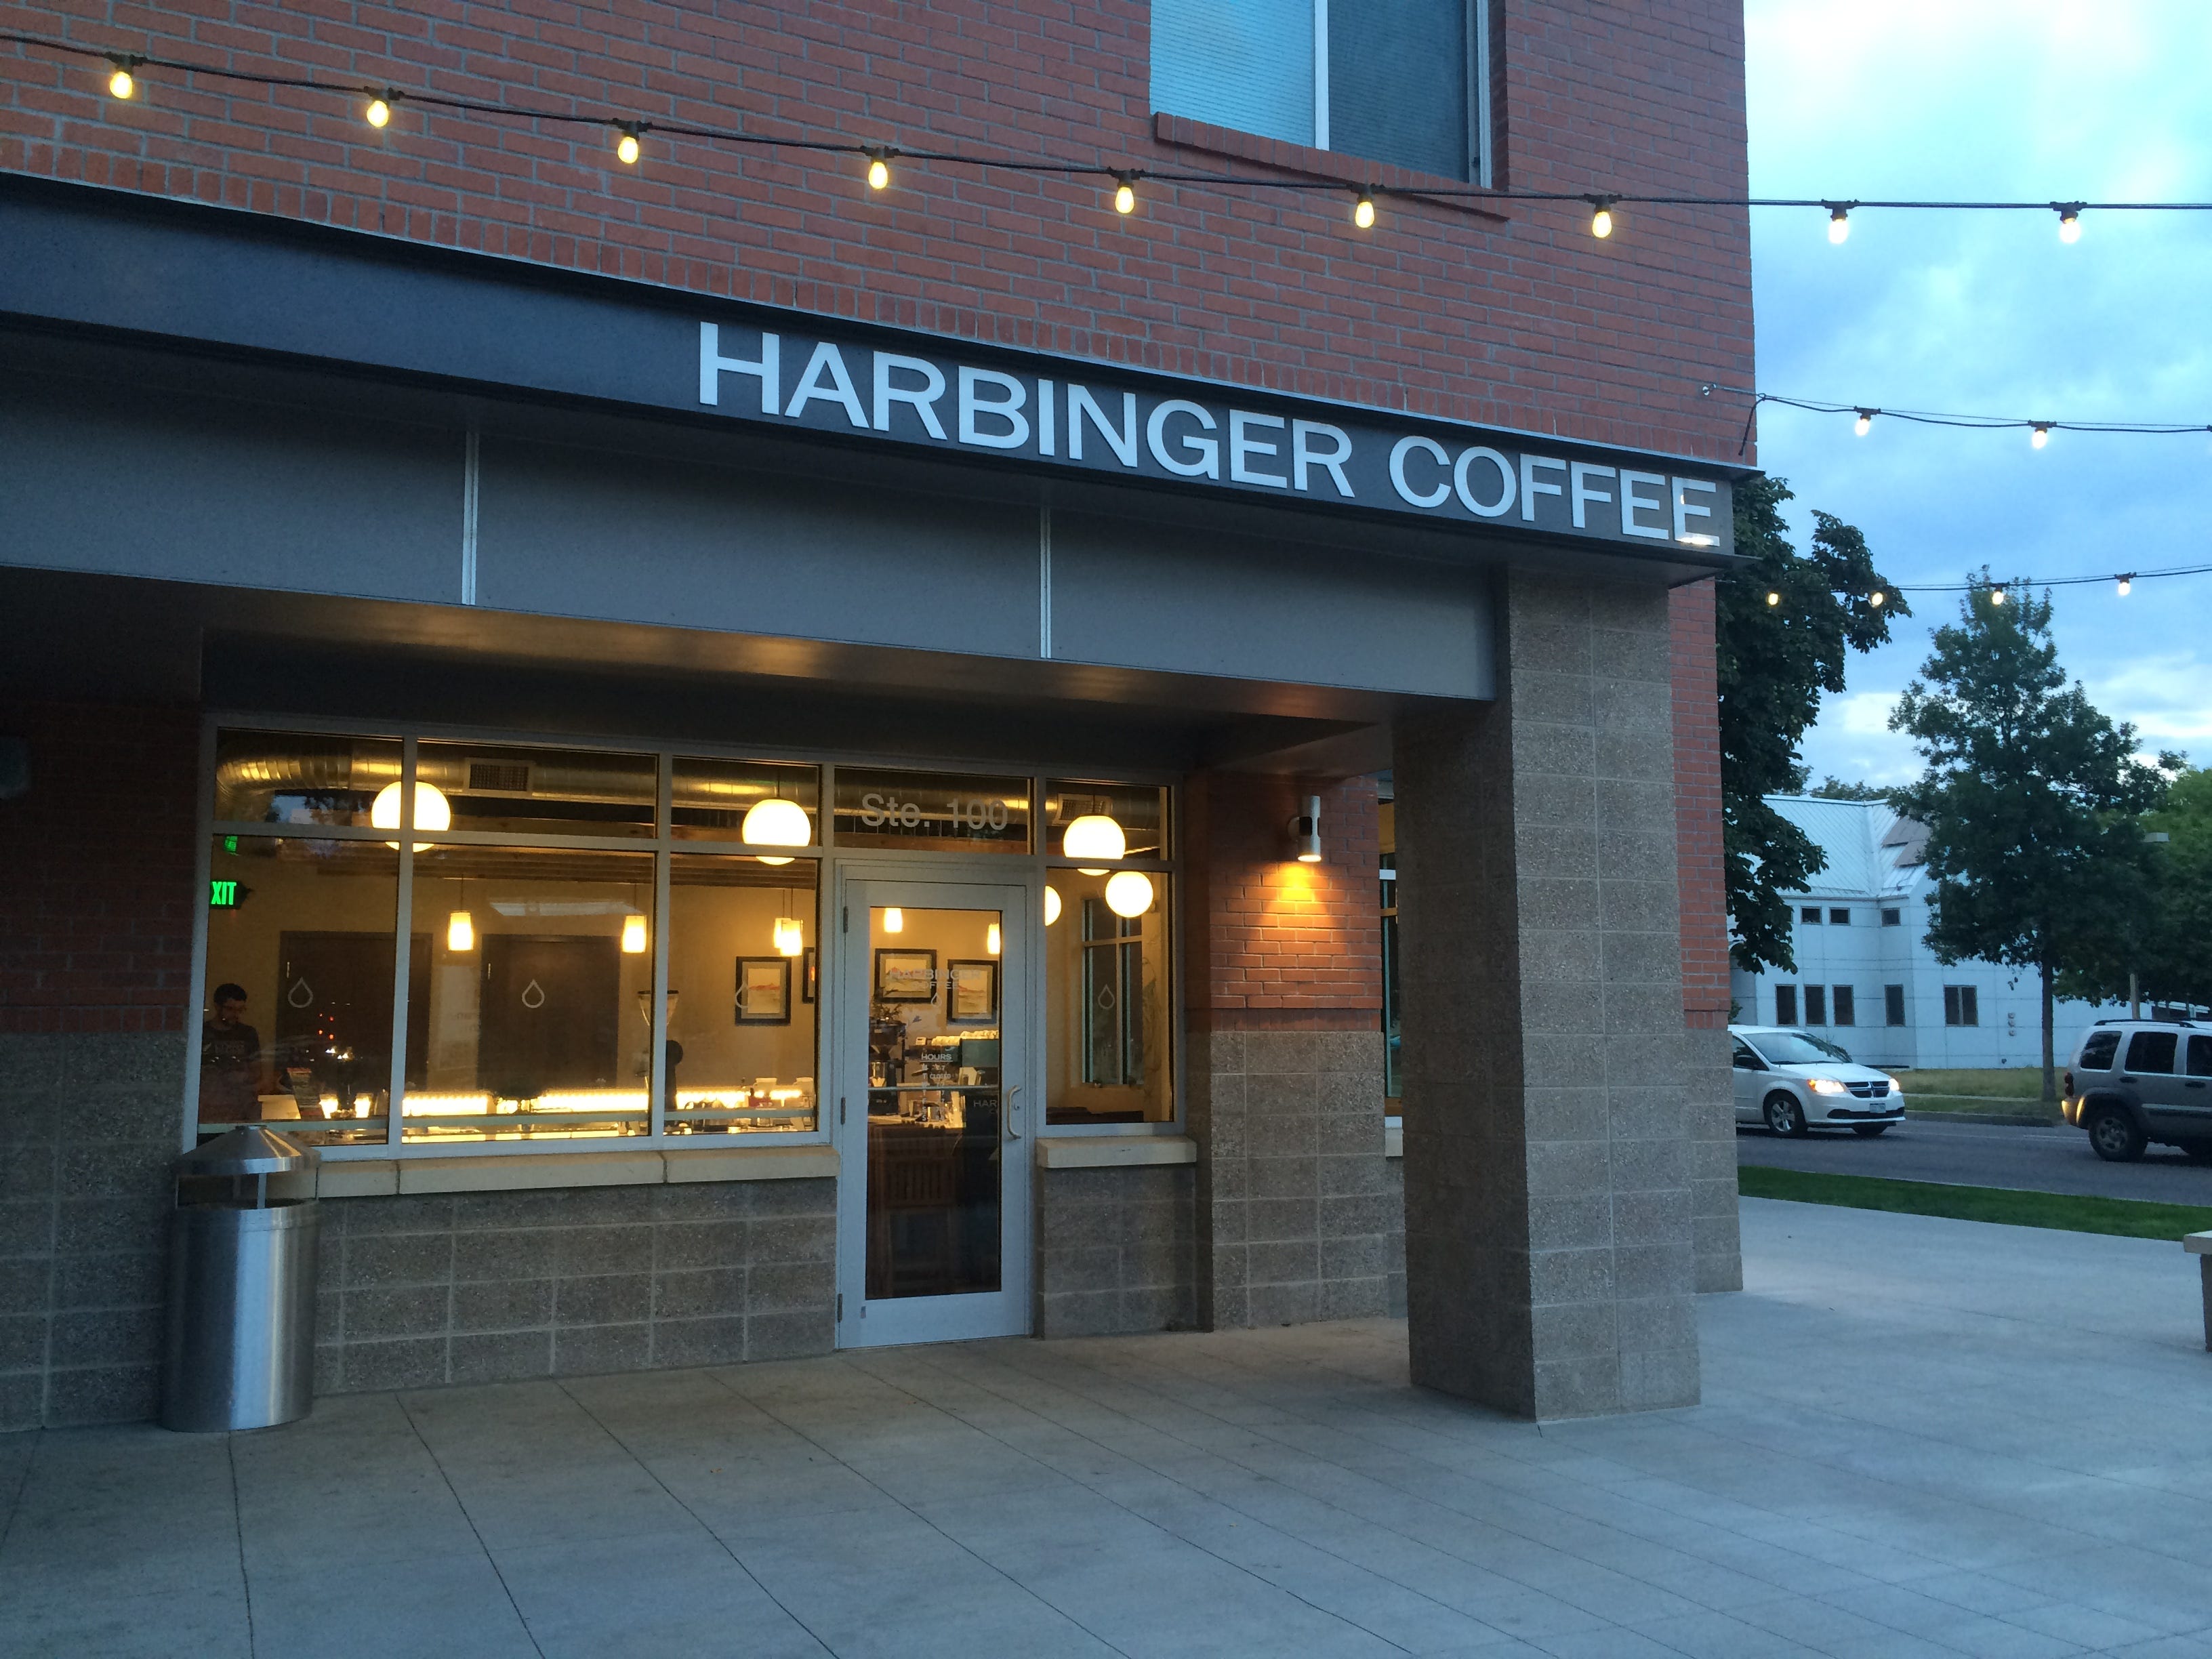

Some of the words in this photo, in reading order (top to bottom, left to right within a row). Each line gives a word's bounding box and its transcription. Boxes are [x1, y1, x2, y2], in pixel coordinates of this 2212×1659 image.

[699, 321, 1355, 499] HARBINGER
[1389, 436, 1721, 547] COFFEE
[861, 793, 930, 827] Ste.
[946, 798, 1008, 831] 100
[211, 881, 237, 905] XIT
[889, 969, 982, 980] HARBINGER
[921, 1052, 952, 1061] HOURS
